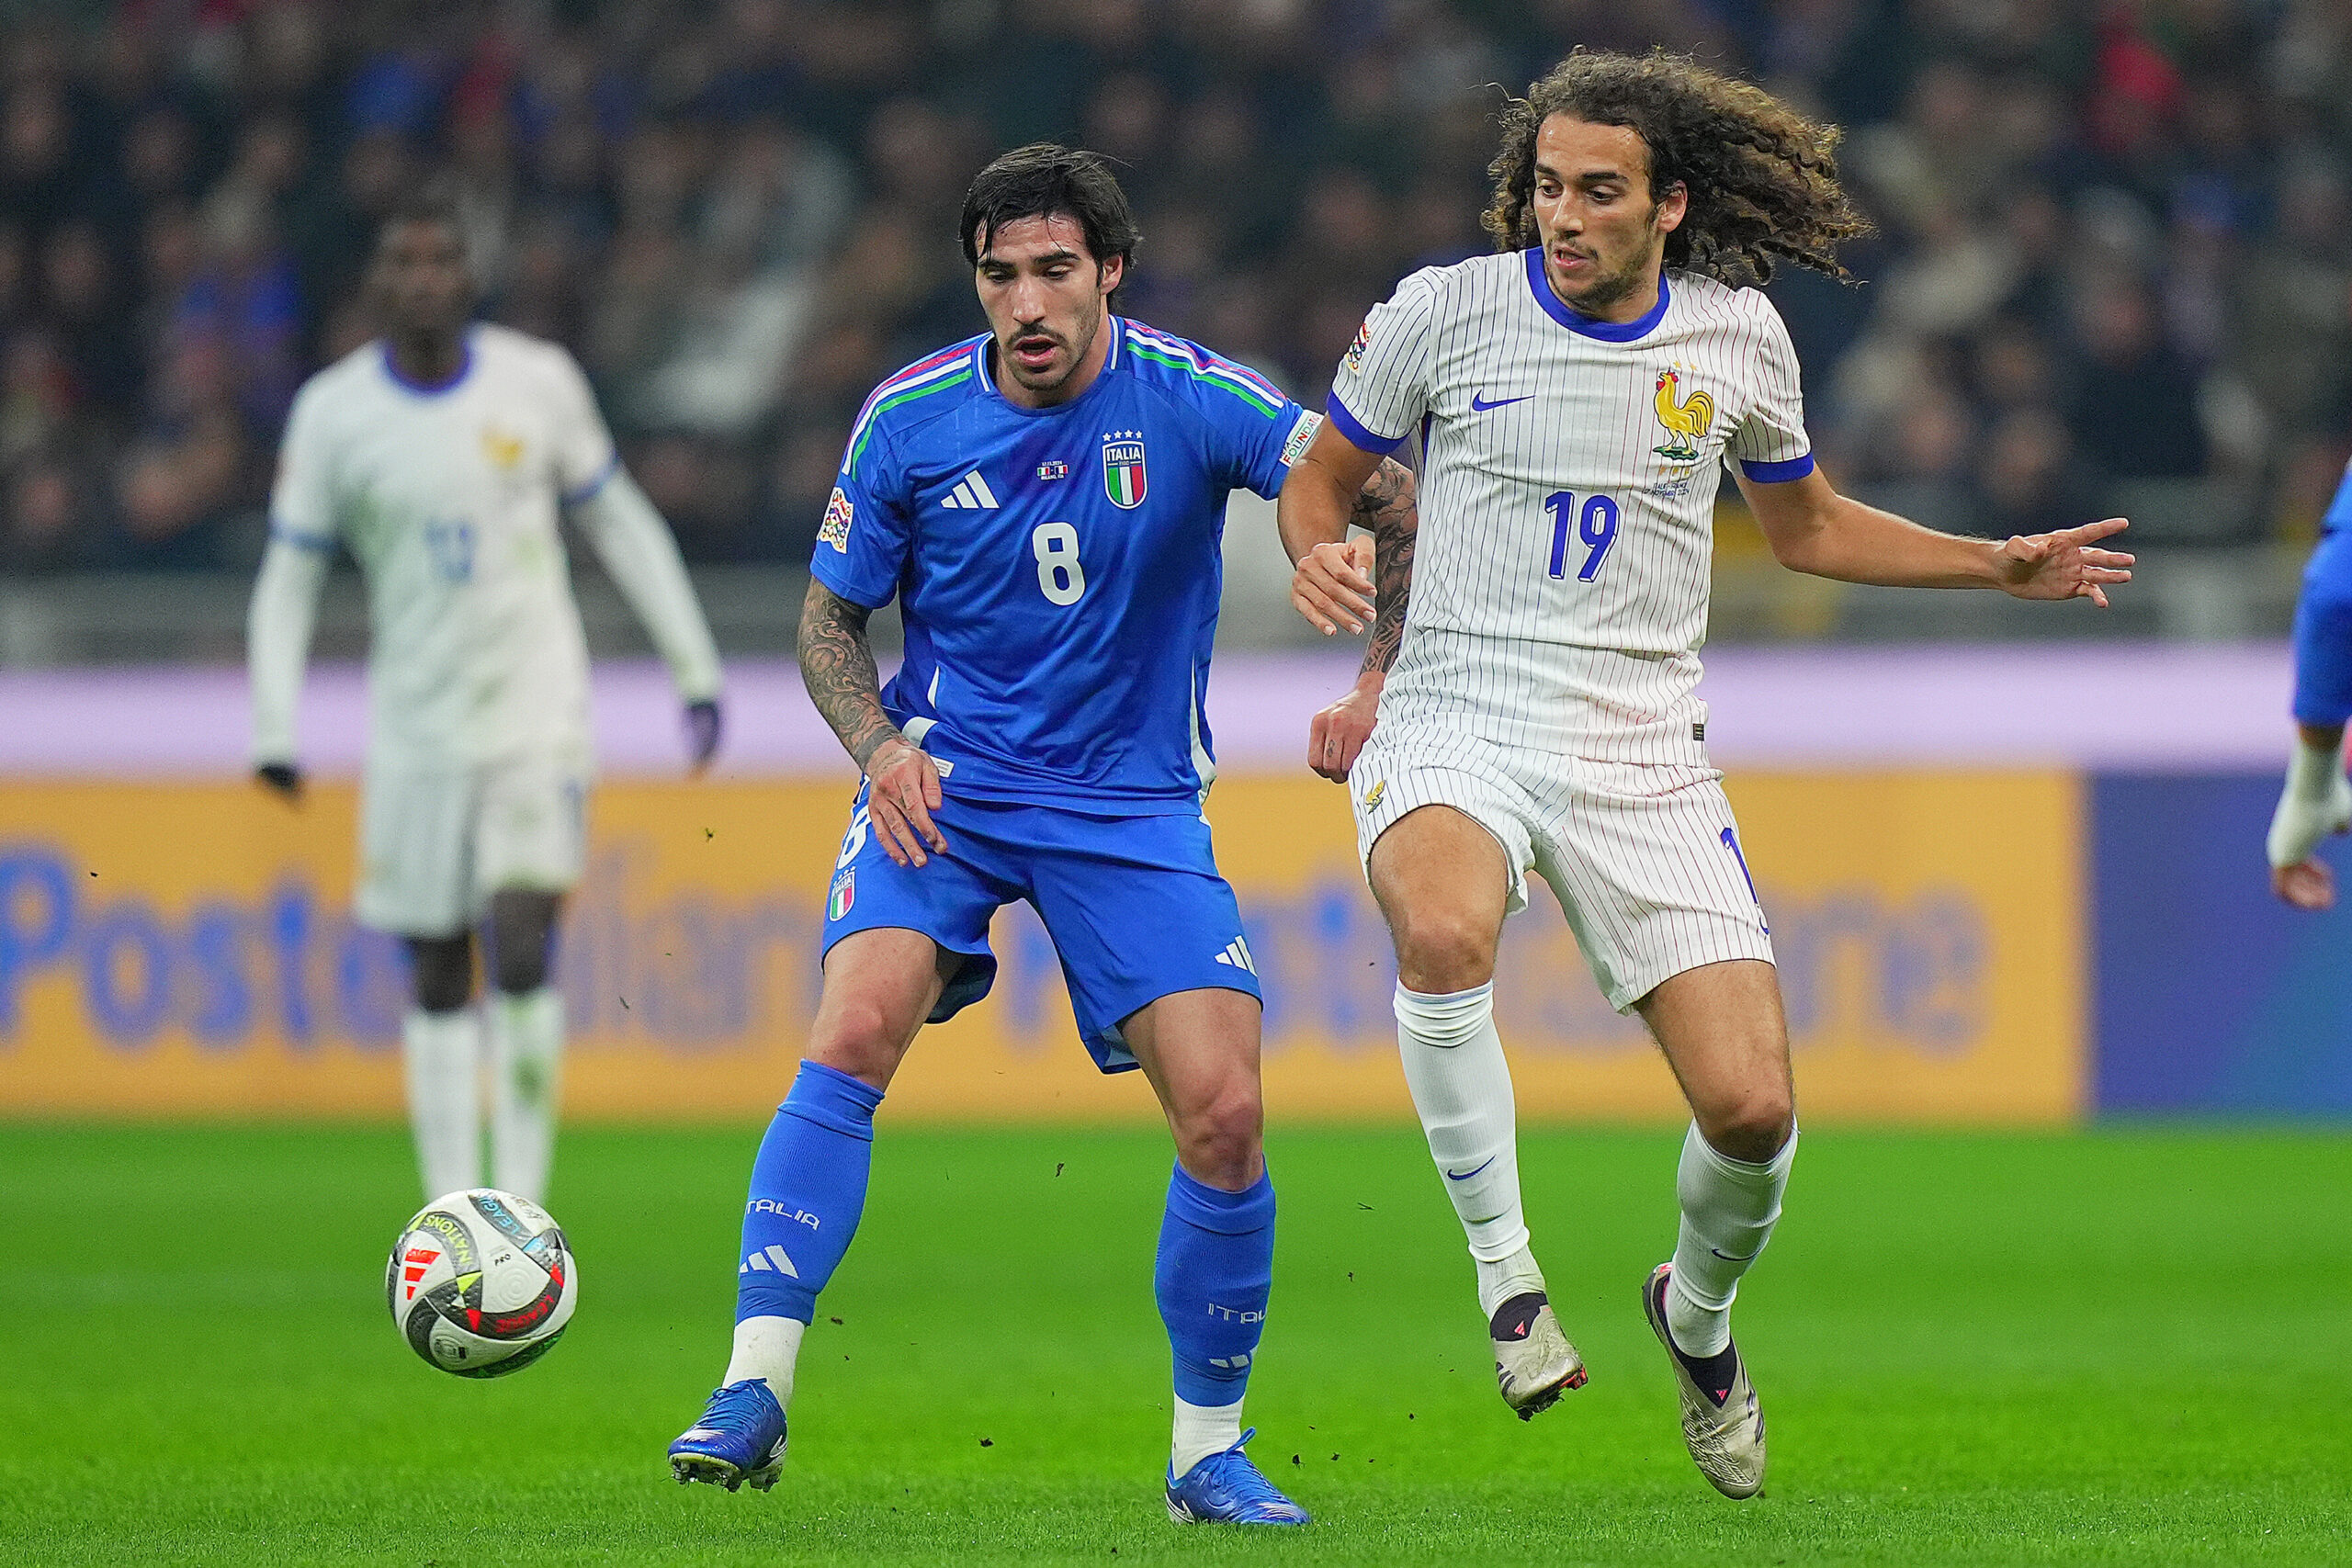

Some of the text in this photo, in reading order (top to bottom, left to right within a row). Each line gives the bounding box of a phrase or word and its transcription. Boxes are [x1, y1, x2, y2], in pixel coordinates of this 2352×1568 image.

[1106, 446, 1142, 462] ITALIA
[1544, 491, 1621, 583] 19
[1033, 522, 1086, 606] 8
[424, 1214, 473, 1265] NATIONS
[496, 1294, 555, 1334] LEAGUE
